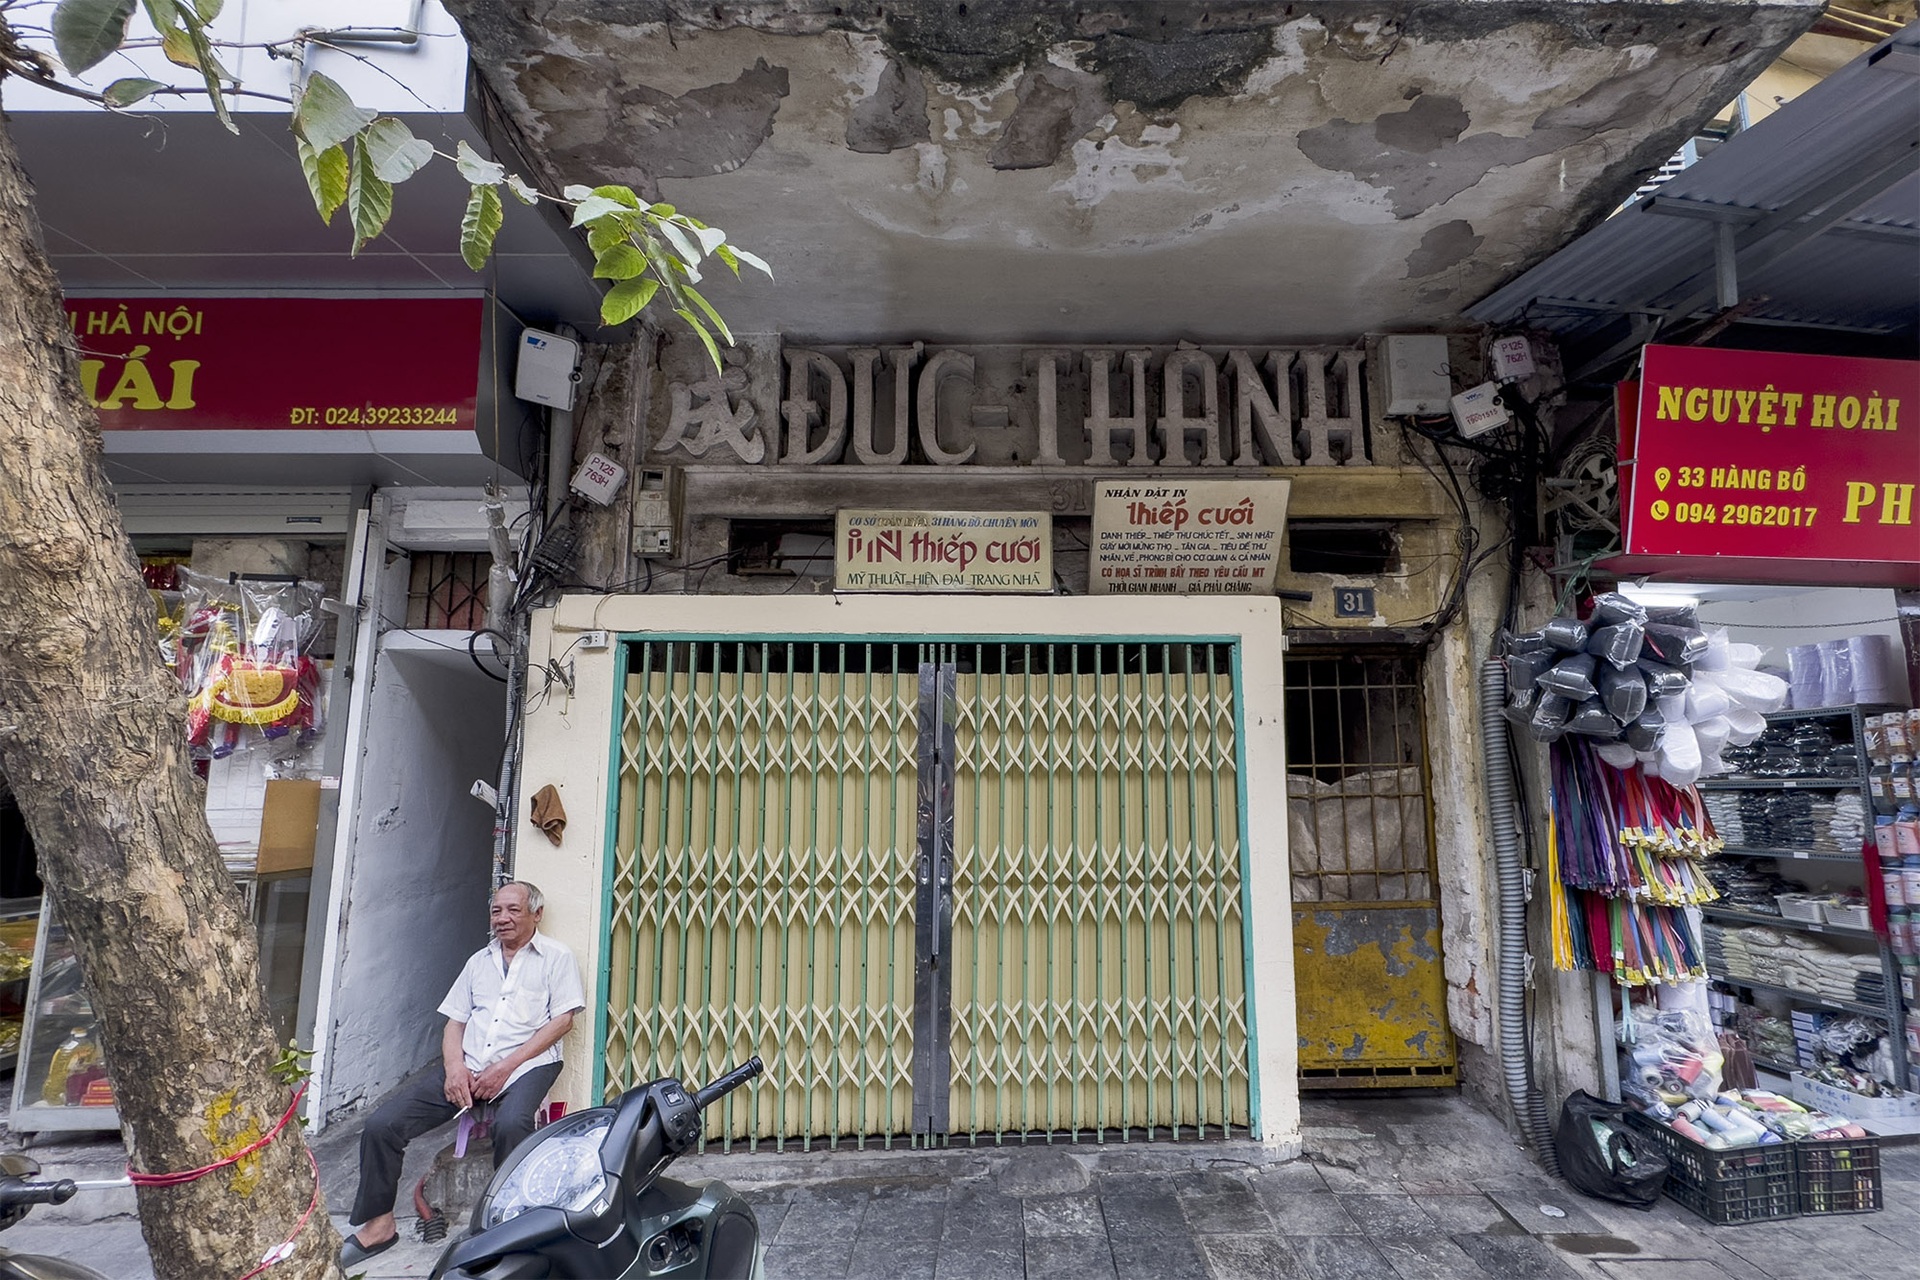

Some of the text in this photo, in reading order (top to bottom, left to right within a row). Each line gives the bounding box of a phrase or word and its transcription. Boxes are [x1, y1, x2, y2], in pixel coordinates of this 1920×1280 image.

[86, 303, 132, 335] HÀ
[142, 305, 203, 341] NỘI
[290, 407, 458, 425] ĐT: 024.39233244
[1656, 384, 1900, 433] NGUYỆT HOÀI
[591, 456, 617, 477] P125
[584, 467, 610, 488] 763H
[1678, 464, 1807, 491] 33 HÀNG BỒ
[1172, 489, 1188, 498] IN
[1842, 481, 1915, 525] PH
[1126, 496, 1254, 531] thiếp cưới
[1675, 502, 1818, 527] 094 2962017
[1101, 531, 1123, 540] DANH
[1236, 531, 1253, 540] SINH
[909, 531, 977, 573] thiếp
[986, 535, 1040, 563] cưới
[1197, 542, 1211, 551] GIA
[1175, 553, 1192, 562] CHO
[1206, 553, 1228, 562] QUAN
[847, 570, 866, 585] MỸ
[970, 574, 1010, 586] TRANG
[1013, 571, 1041, 585] NHÃ
[1101, 564, 1114, 578] CÓ
[1189, 567, 1210, 578] THEO
[1213, 565, 1230, 578] YÊU
[1252, 567, 1265, 578] MT
[1128, 582, 1148, 593] GIAN
[1149, 582, 1177, 593] NHANH
[1343, 592, 1366, 612] 31
